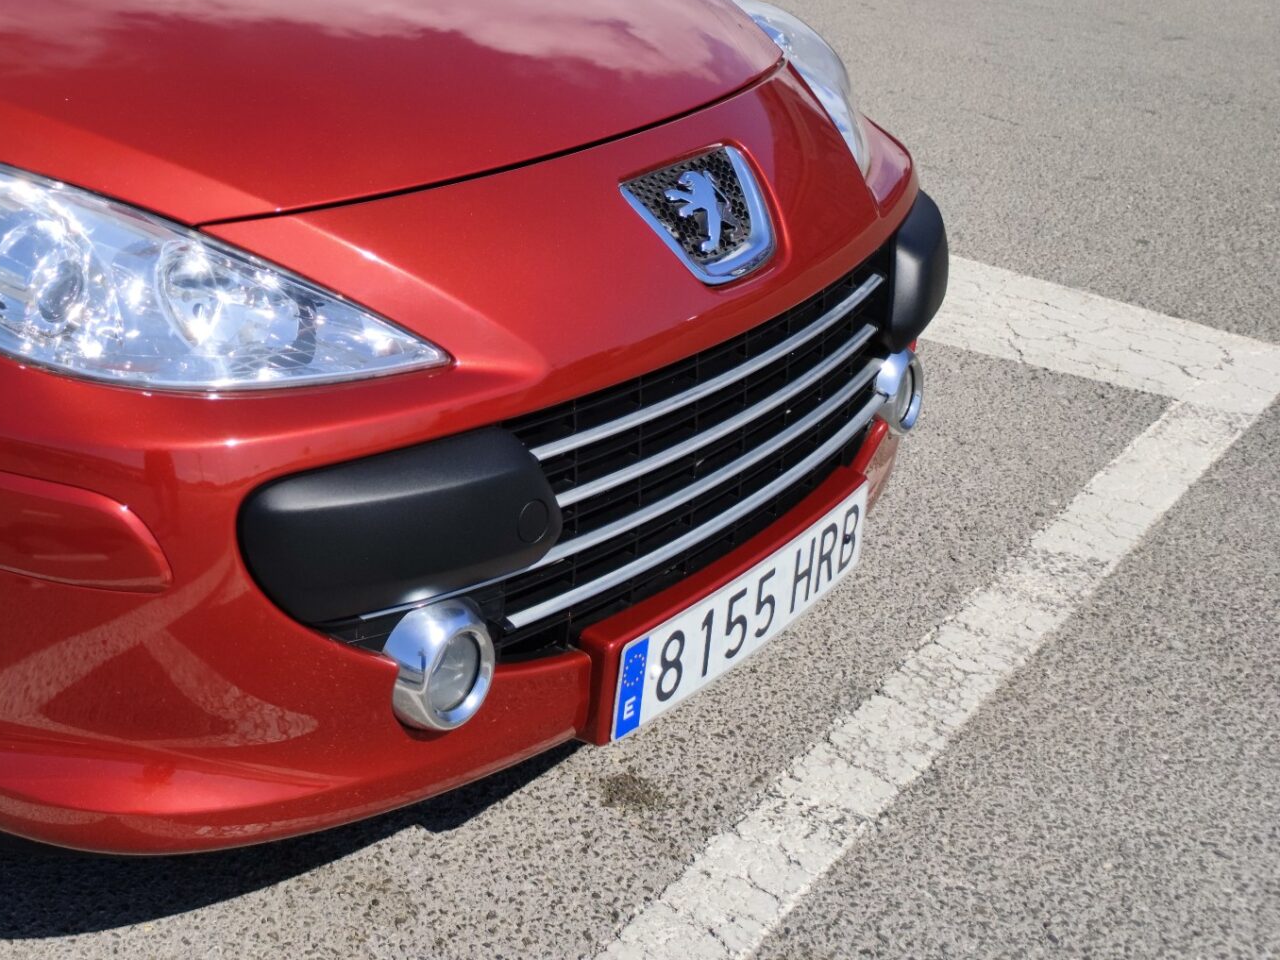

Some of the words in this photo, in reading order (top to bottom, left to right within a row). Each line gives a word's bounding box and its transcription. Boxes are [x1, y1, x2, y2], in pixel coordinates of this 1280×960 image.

[655, 567, 776, 703] 8155
[789, 503, 860, 615] HRB
[622, 695, 637, 721] E
